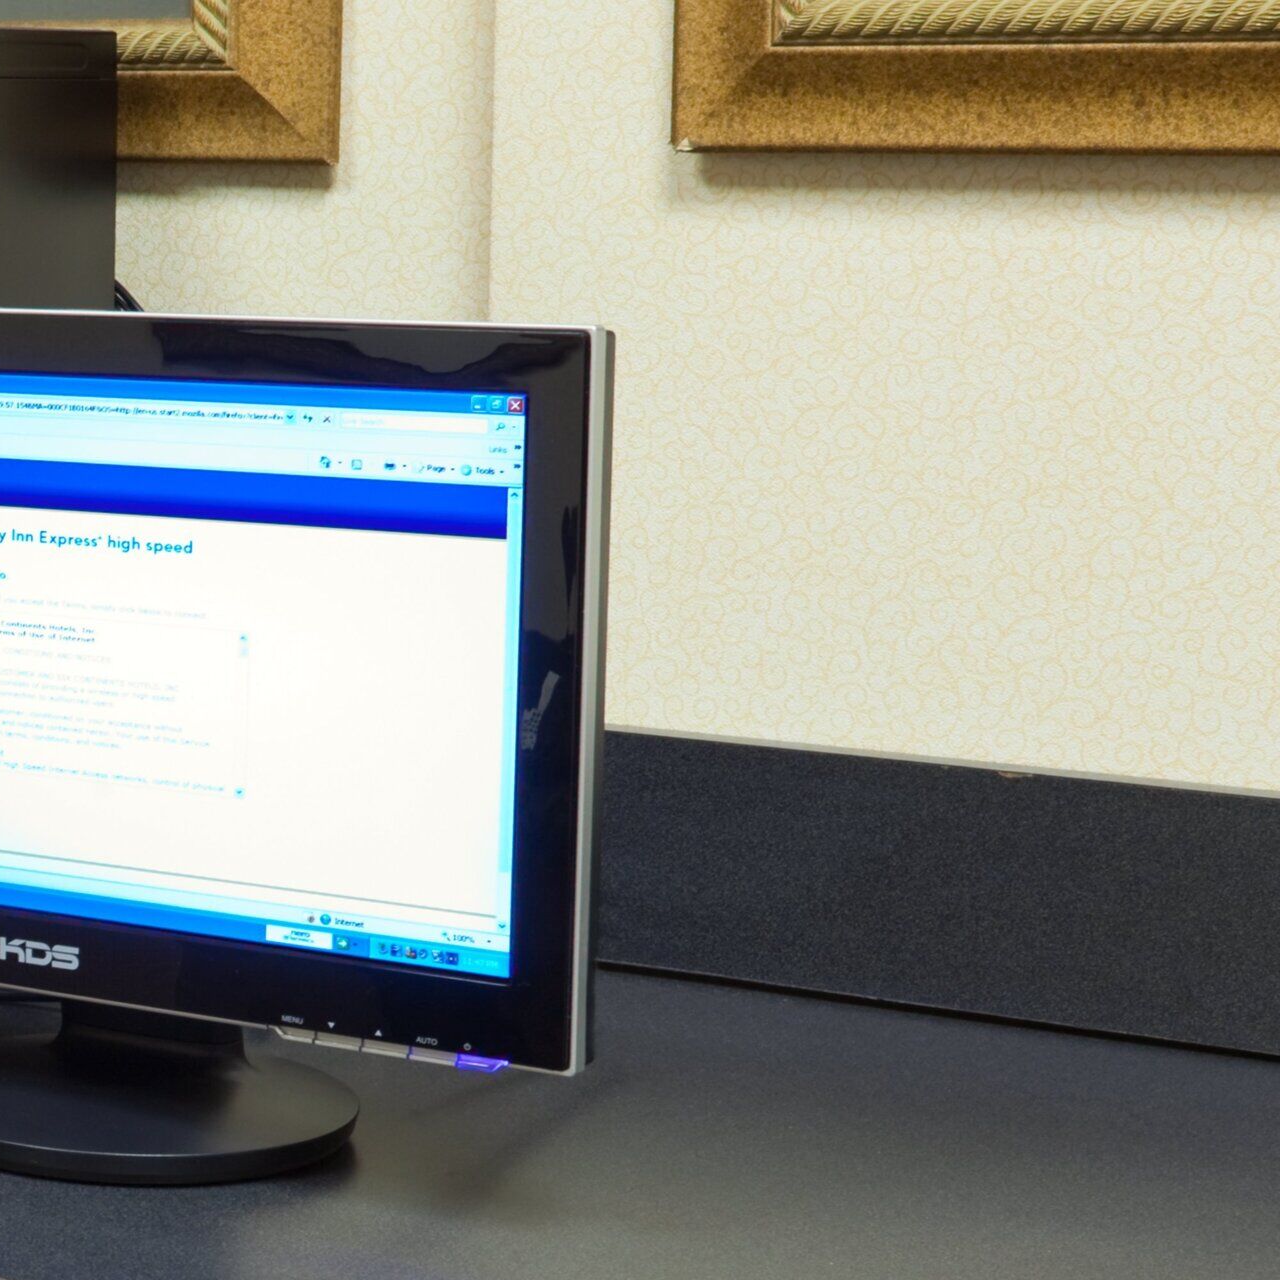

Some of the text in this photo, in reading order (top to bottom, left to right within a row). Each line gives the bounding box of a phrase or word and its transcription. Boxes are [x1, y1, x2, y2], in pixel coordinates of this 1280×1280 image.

[426, 464, 446, 474] Page
[475, 466, 496, 476] Tools
[12, 529, 34, 543] Inn
[107, 535, 142, 554] high
[146, 539, 194, 556] speed
[334, 917, 364, 928] Internet
[452, 934, 475, 944] 100%
[0, 936, 79, 971] KDS
[281, 1015, 304, 1025] MENU
[416, 1036, 438, 1047] AUTO
